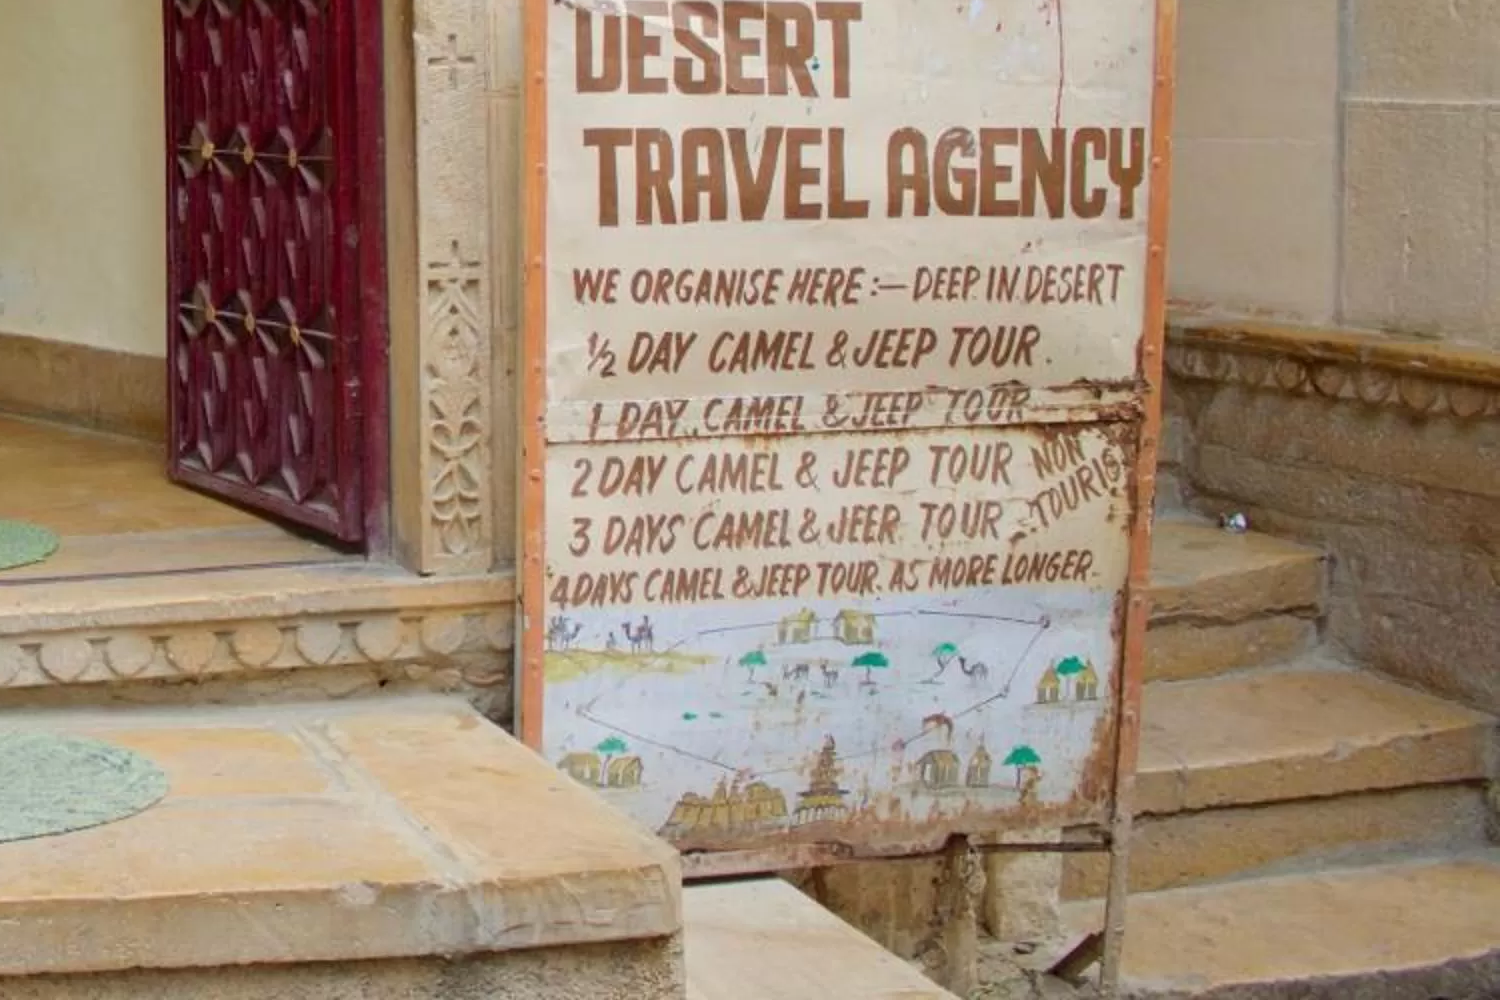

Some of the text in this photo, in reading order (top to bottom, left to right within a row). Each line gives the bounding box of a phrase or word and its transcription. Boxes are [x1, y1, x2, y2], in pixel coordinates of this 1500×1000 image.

[575, 0, 861, 99] DESERT
[583, 126, 1145, 227] TRAVEL AGENCY
[572, 268, 620, 304] WE
[631, 268, 782, 305] ORGANISE
[787, 267, 866, 306] HERE
[1024, 264, 1124, 304] DESERT
[628, 332, 696, 374] DAY
[709, 329, 815, 373] CAMEL
[590, 403, 601, 439] 1
[703, 396, 805, 433] CAMEL
[946, 387, 1030, 421] TOUR
[571, 442, 1013, 497] 2 DAY CAMEL & JEEP TOUR
[1030, 433, 1085, 480] NON
[569, 517, 592, 557] 3
[603, 513, 684, 555] DAYS
[694, 510, 793, 549] CAMEL
[921, 501, 1003, 539] TOUR
[643, 567, 723, 602] CAMEL
[889, 560, 920, 592] AS
[928, 554, 999, 588] MORE
